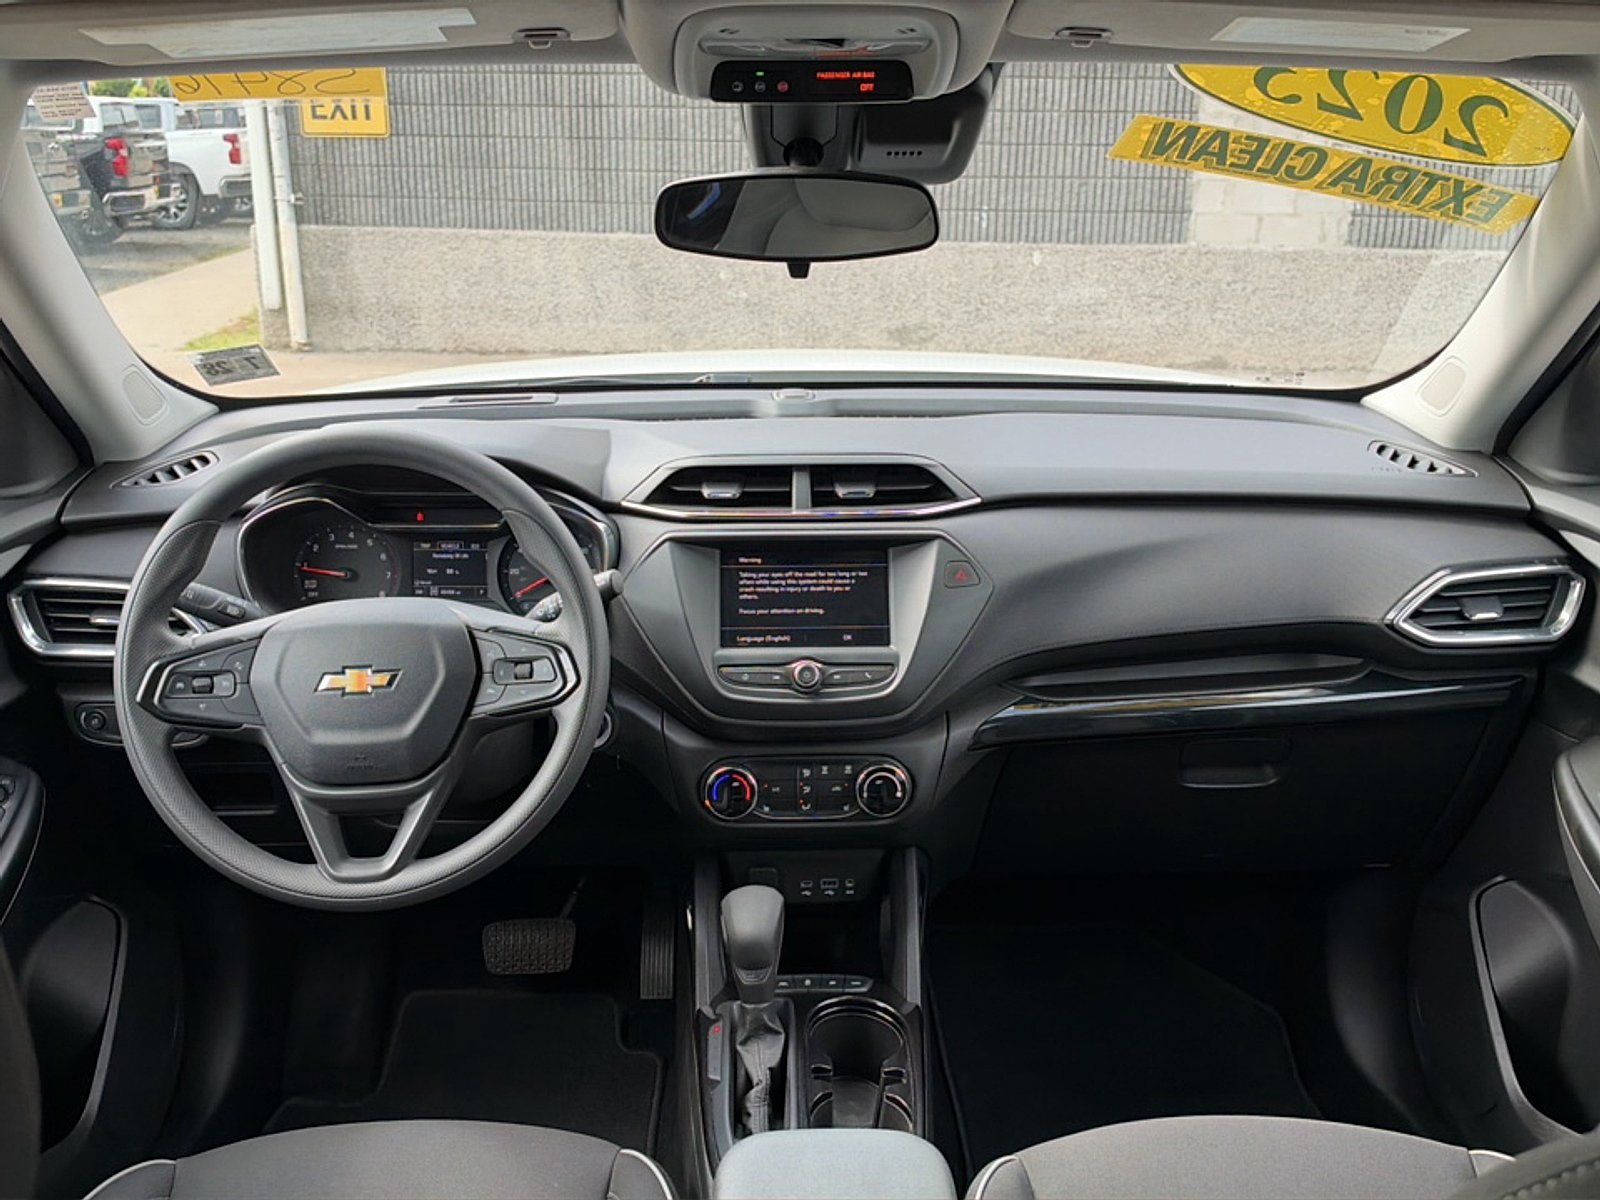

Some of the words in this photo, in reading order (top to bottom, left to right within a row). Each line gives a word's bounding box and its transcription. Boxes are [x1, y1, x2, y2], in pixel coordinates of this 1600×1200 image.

[859, 83, 875, 92] OFF
[739, 557, 762, 565] Warning
[739, 571, 757, 579] Taking
[758, 571, 769, 579] your
[771, 571, 783, 579] eyes
[838, 571, 849, 579] long
[737, 635, 764, 643] Language
[765, 635, 790, 643] (English)
